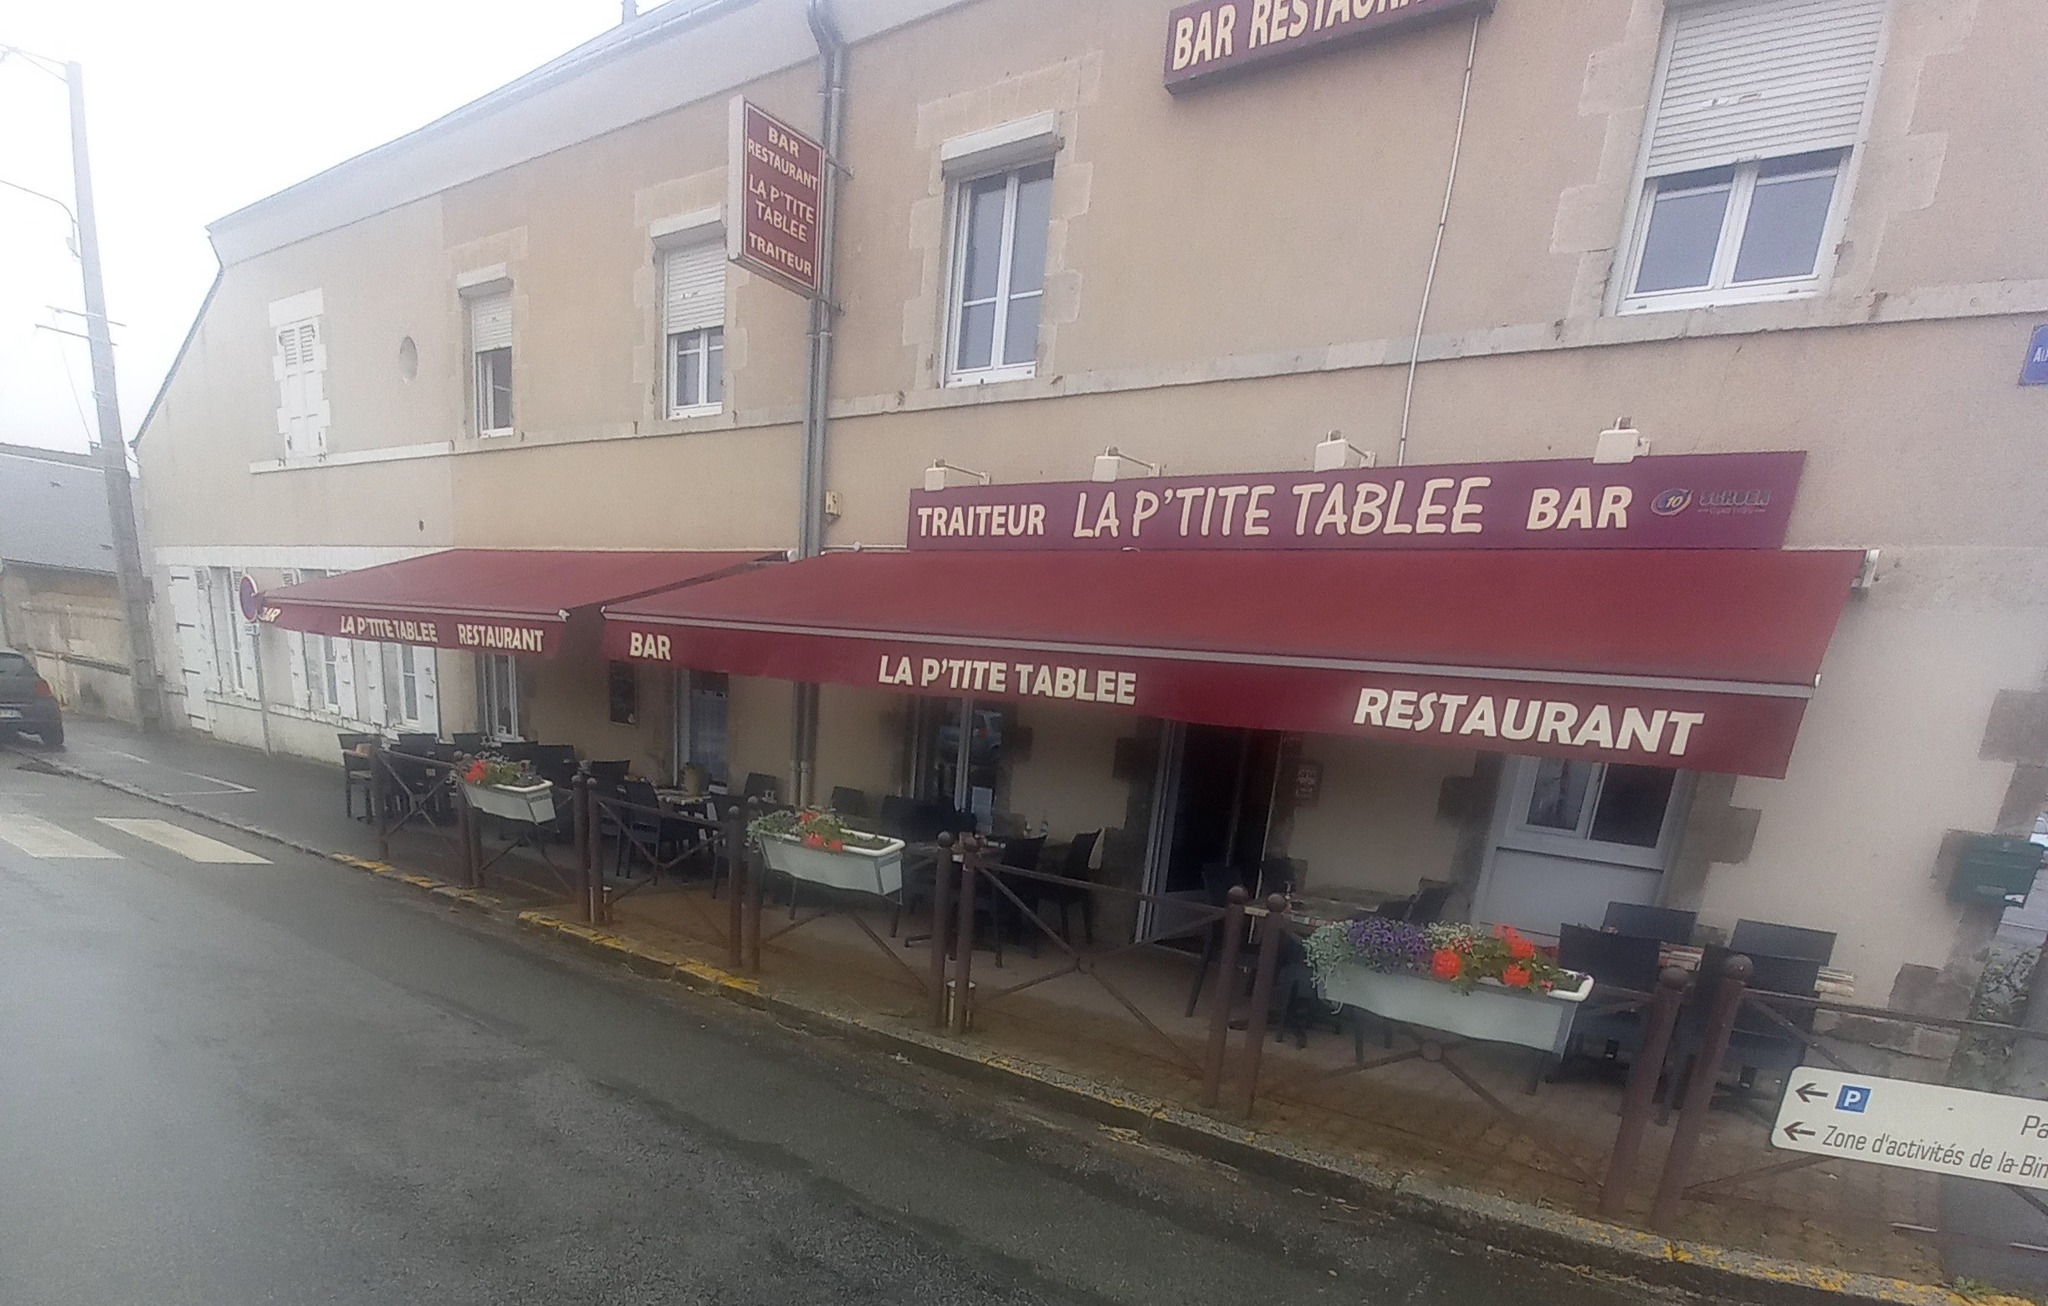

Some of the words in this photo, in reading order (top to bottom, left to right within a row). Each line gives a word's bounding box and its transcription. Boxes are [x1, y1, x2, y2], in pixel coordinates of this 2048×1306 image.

[1172, 4, 1237, 71] BAR
[748, 138, 818, 191] RESTAURANT
[768, 126, 799, 158] BAR
[749, 174, 767, 199] LA
[770, 185, 814, 225] P'TITE
[755, 200, 807, 243] TABLEE
[749, 232, 812, 277] TRAITEUR
[917, 504, 1046, 537] TRAITEUR
[1073, 492, 1119, 538] LA
[1132, 484, 1275, 537] P'TITE
[1292, 477, 1491, 536] TABLEE
[1526, 486, 1633, 531] BAR
[340, 615, 355, 635] LA
[392, 620, 438, 643] TABLEE
[456, 623, 544, 652] RESTAURANT
[630, 632, 671, 660] BAR
[878, 655, 913, 686] LA
[921, 657, 1007, 693] P'TITE
[1015, 663, 1137, 705] TABLEE
[1353, 688, 1705, 755] RESTAURANT
[1822, 1125, 1867, 1151] Zone
[1872, 1132, 1965, 1166] d'activités
[1969, 1147, 1993, 1170] de
[2020, 1114, 2048, 1139] Pa
